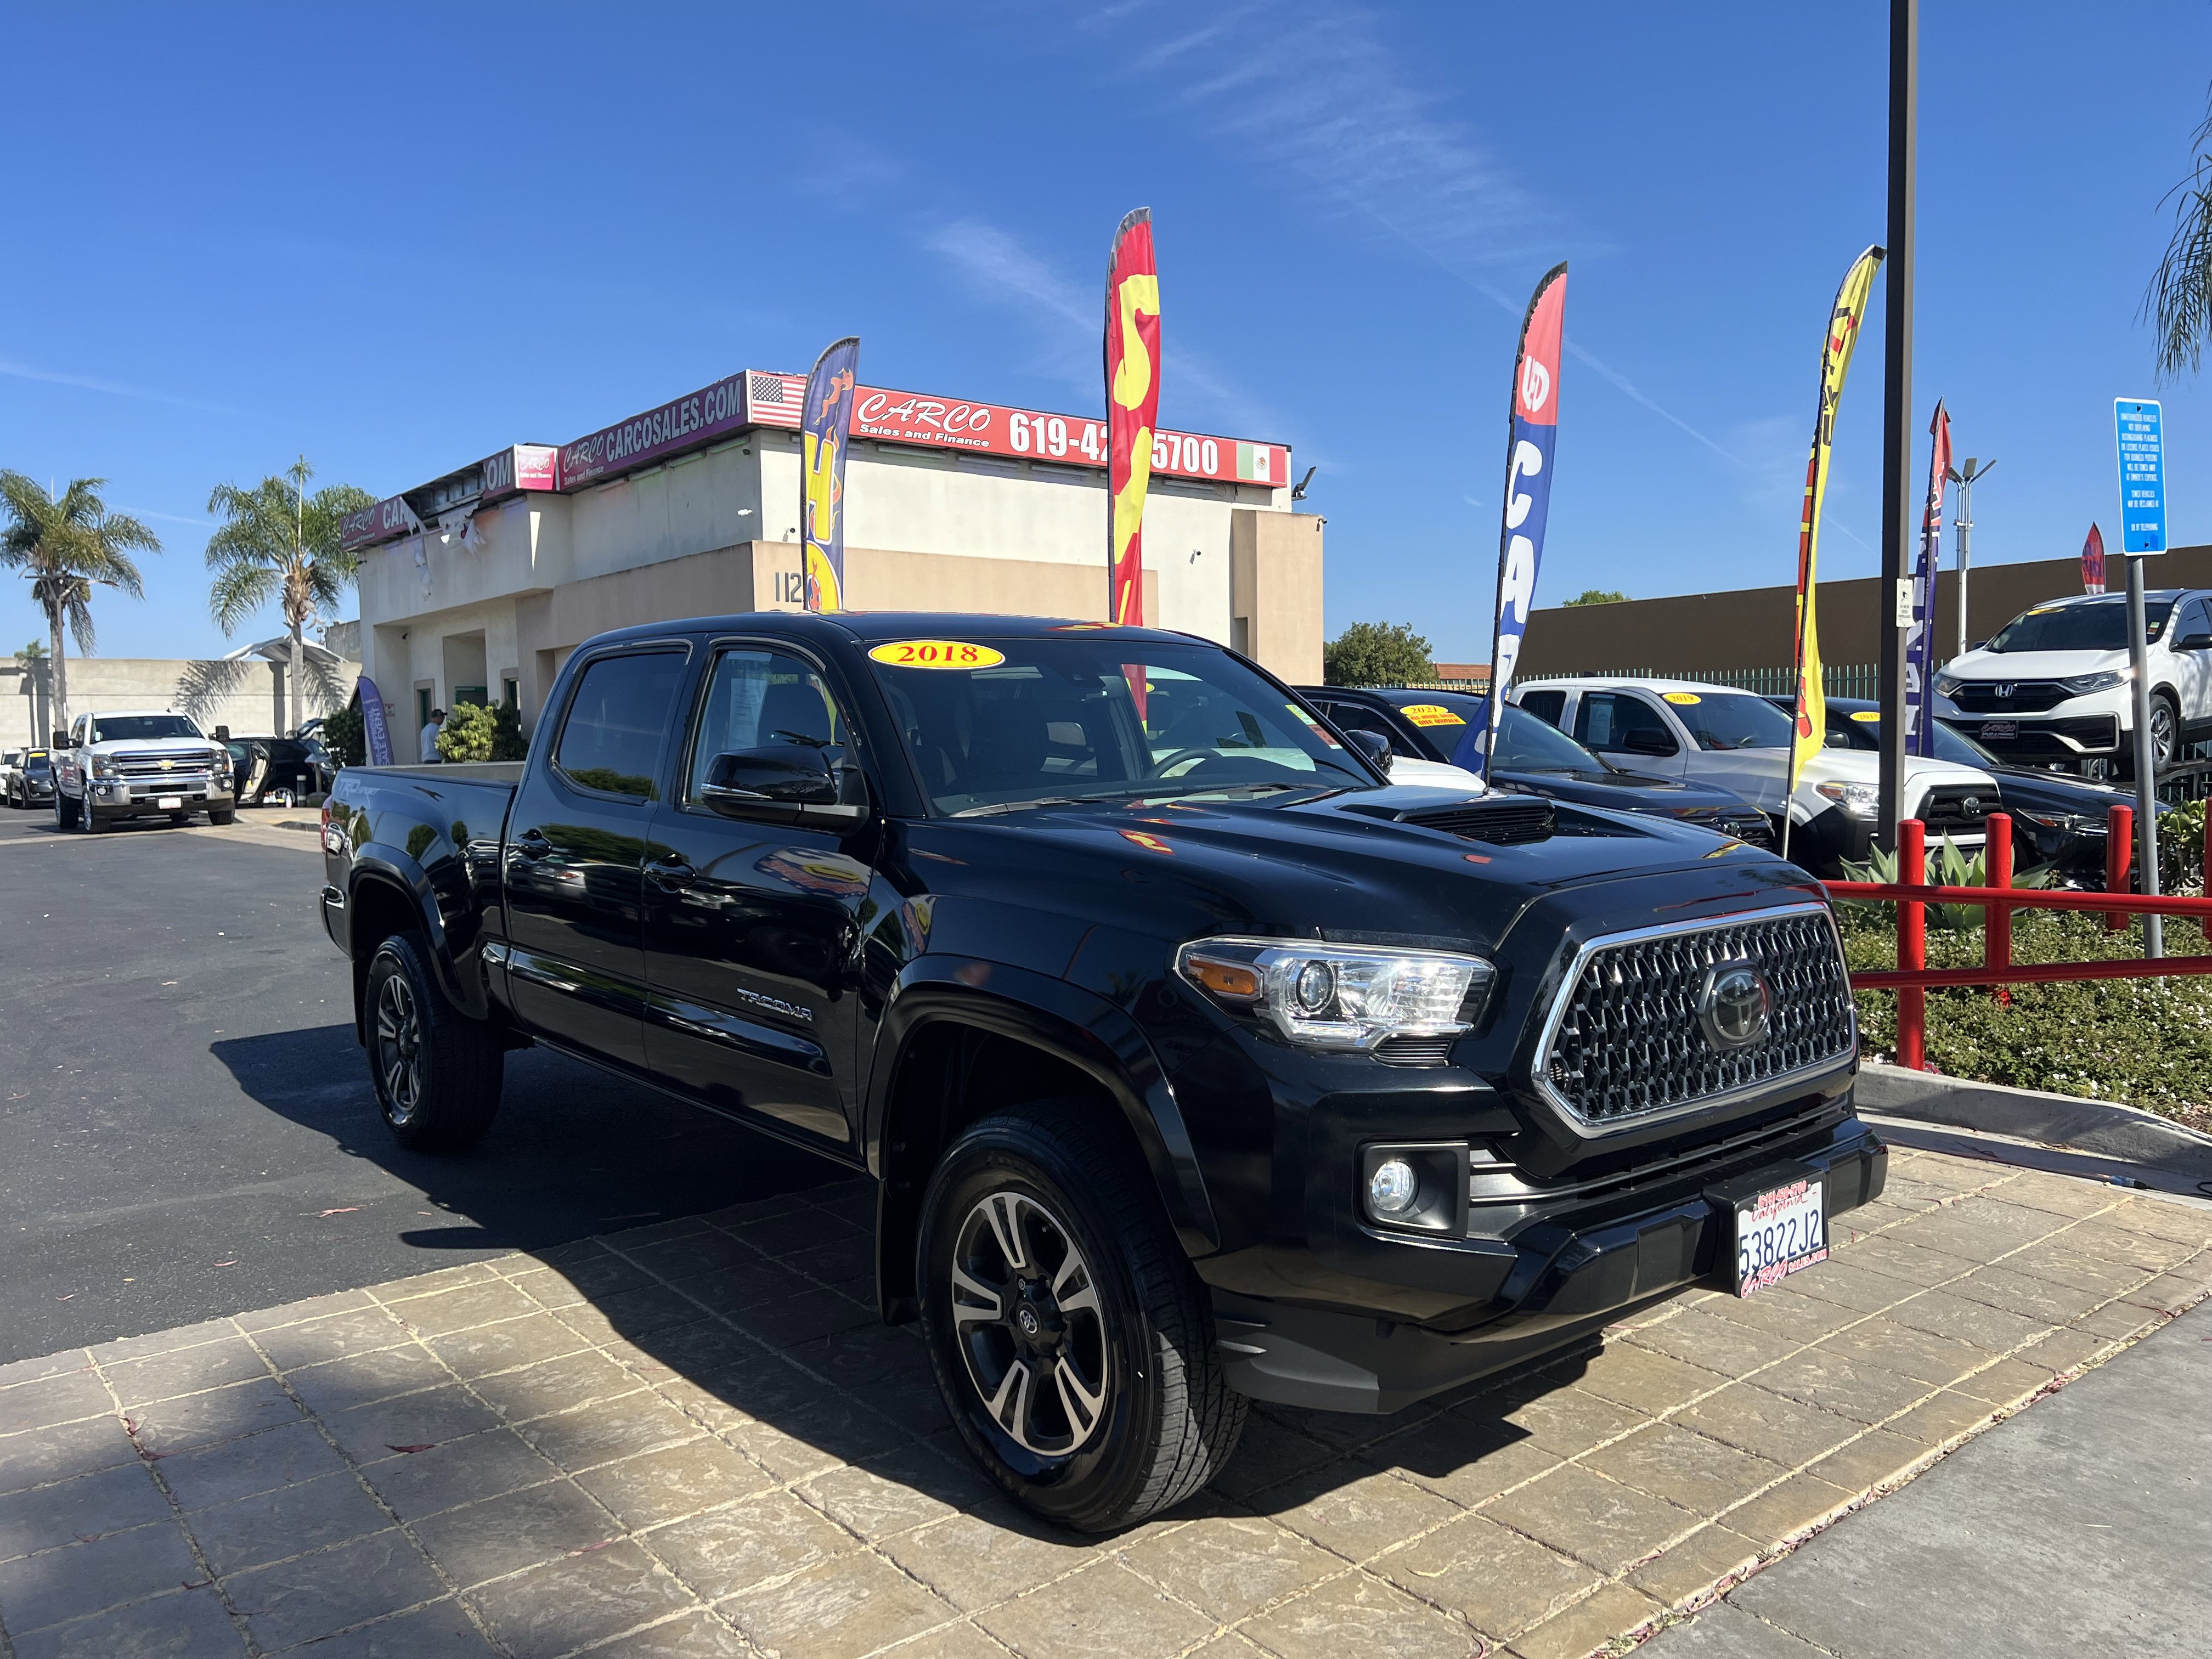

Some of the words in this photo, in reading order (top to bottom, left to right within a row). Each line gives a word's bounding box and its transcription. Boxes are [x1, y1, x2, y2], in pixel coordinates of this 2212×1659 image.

[563, 435, 604, 473] CARCO
[606, 379, 741, 463] CARCOSALES.COM
[857, 393, 991, 433] CARCO
[859, 424, 900, 436] Sales
[904, 430, 931, 440] and
[934, 432, 990, 447] Finance
[564, 475, 576, 486] Sales
[577, 470, 585, 481] and
[585, 465, 604, 478] Finance
[342, 508, 375, 539] CARCO
[897, 645, 978, 662] 2018
[373, 707, 385, 740] EVENT
[340, 777, 362, 798] TRD
[737, 988, 813, 1022] TACOMA
[1752, 1194, 1808, 1222] California
[1757, 1190, 1776, 1209] (619)
[1776, 1180, 1807, 1203] 420-5700
[1739, 1209, 1819, 1276] 53822J2
[1741, 1259, 1788, 1299] CARCO
[1788, 1249, 1828, 1273] SALES.COM
